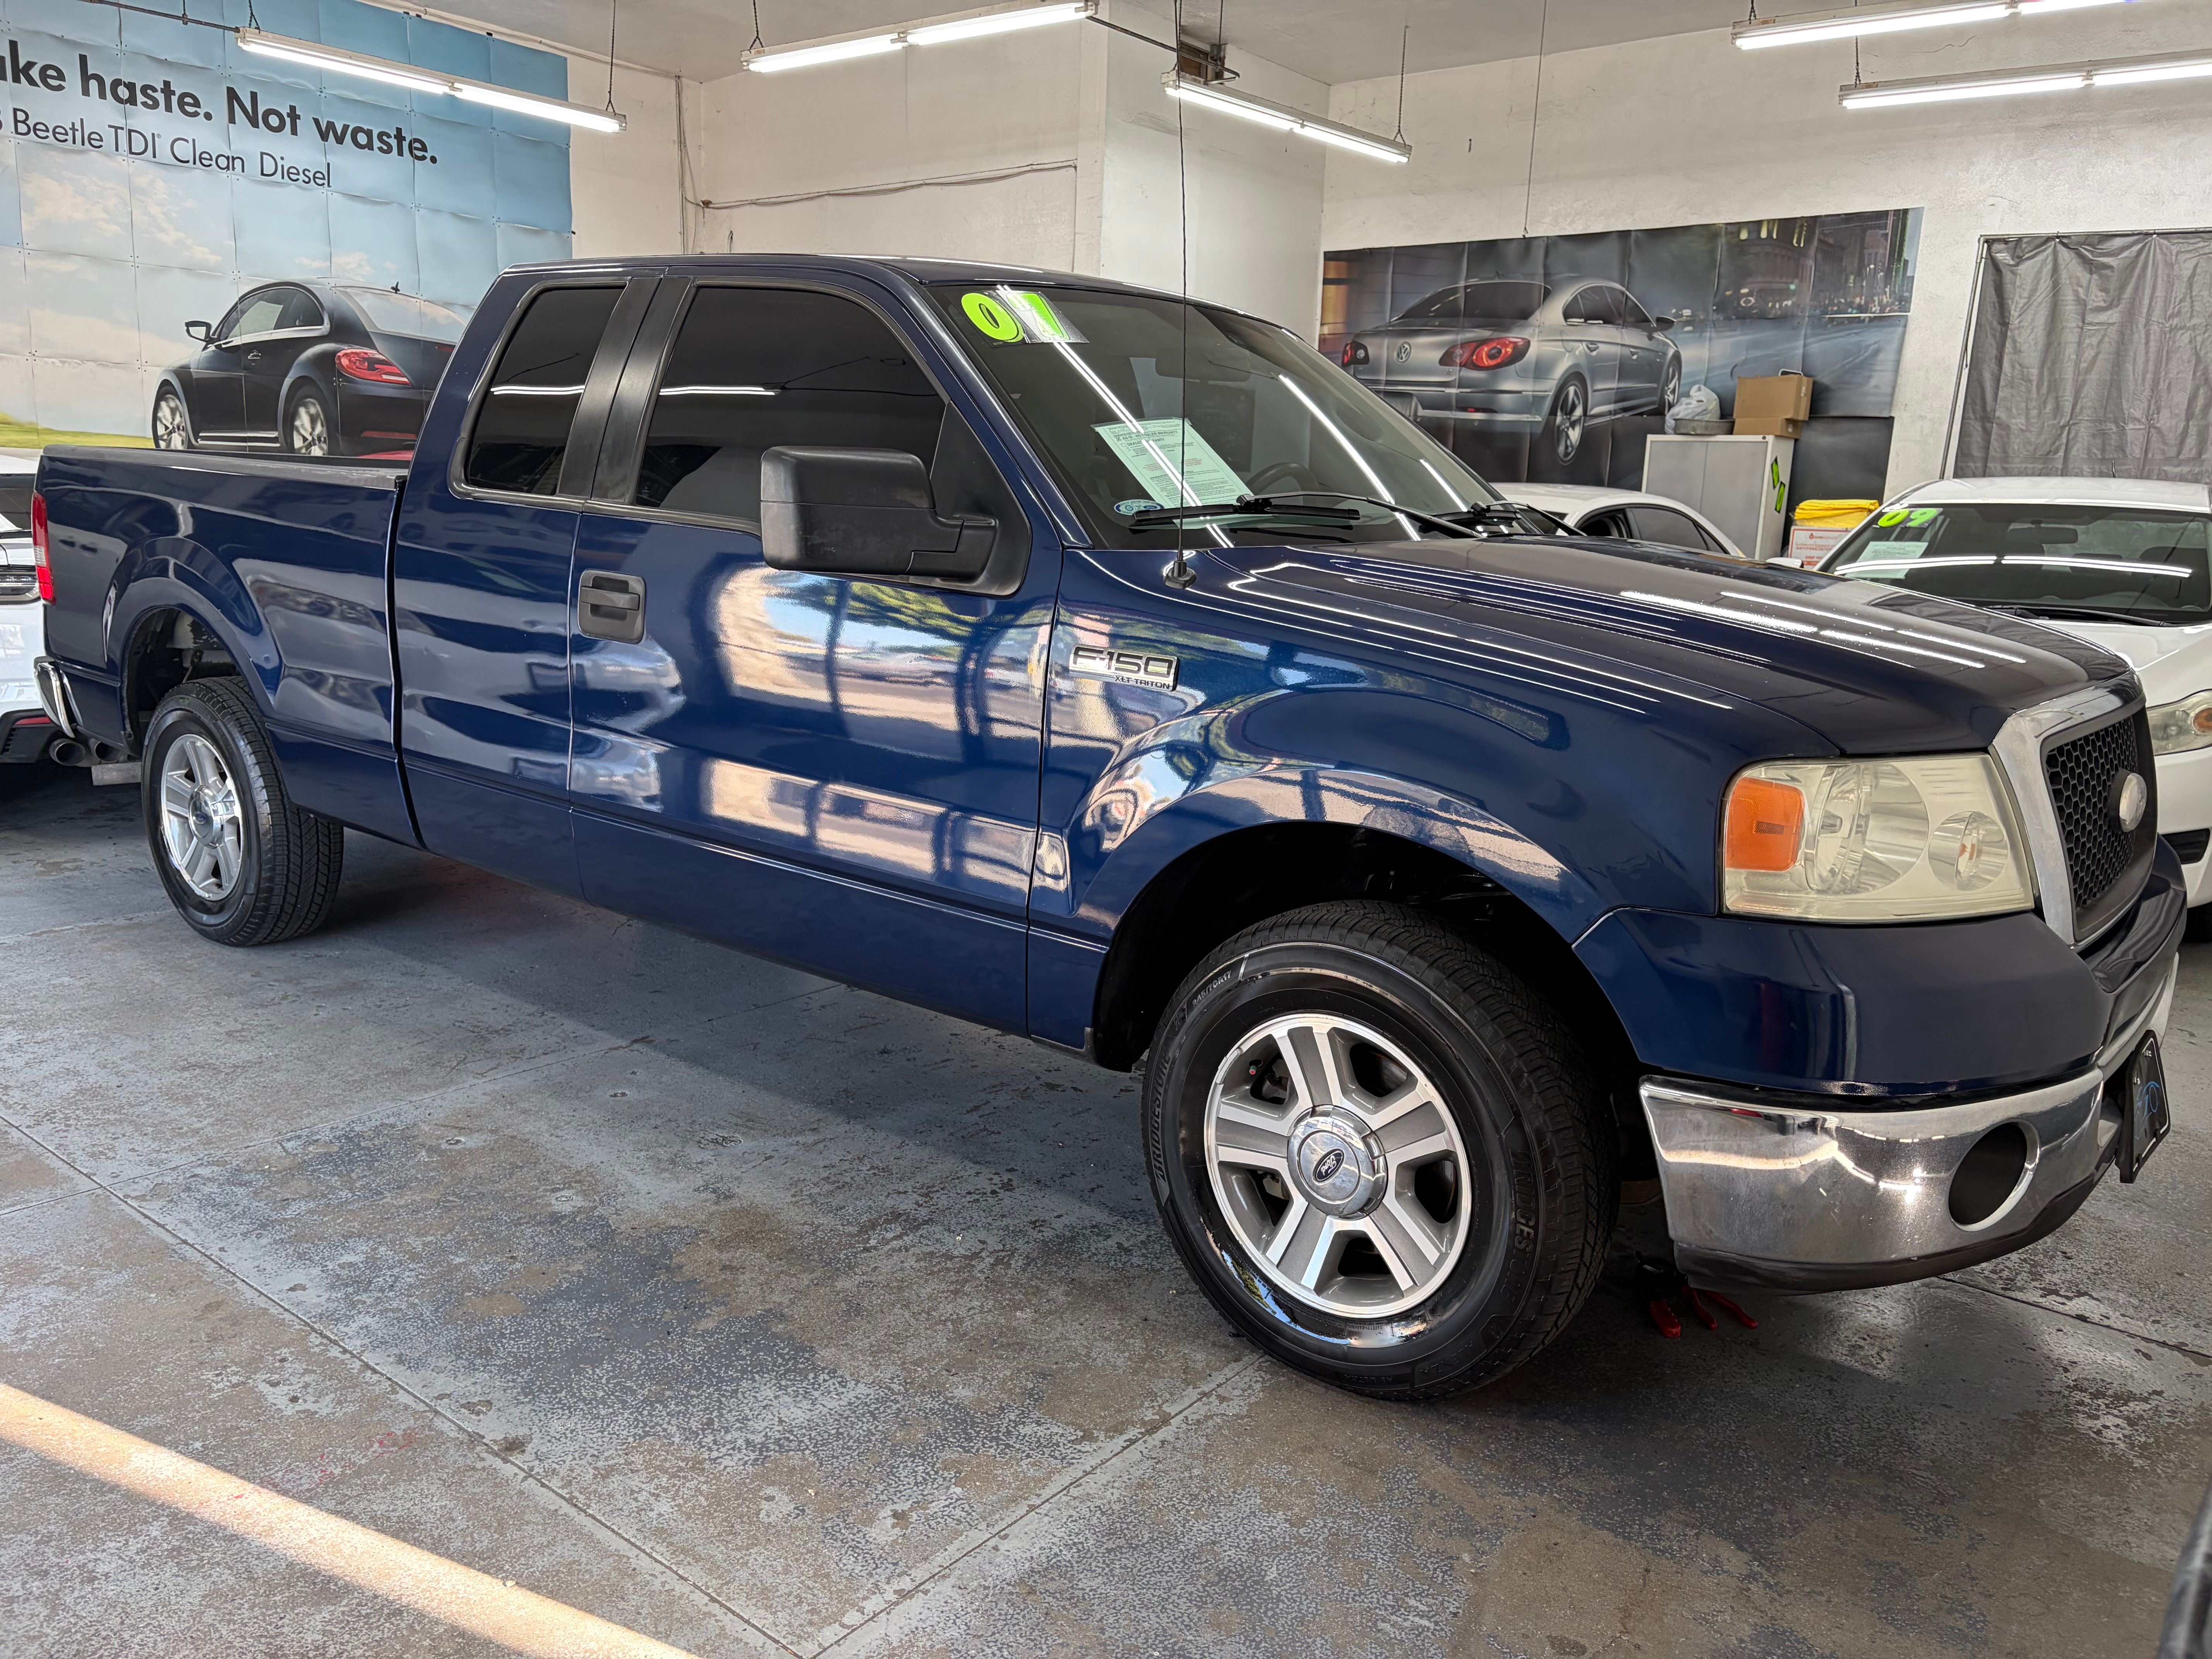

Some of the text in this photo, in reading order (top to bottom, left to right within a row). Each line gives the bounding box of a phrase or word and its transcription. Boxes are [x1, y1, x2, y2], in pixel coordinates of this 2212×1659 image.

[0, 40, 438, 164] ke haste. Not waste.
[13, 107, 103, 149] Beetle
[170, 137, 244, 173] Clean
[260, 151, 331, 188] Diesel
[1878, 508, 1937, 527] 09
[1073, 646, 1173, 678] F-150
[1134, 678, 1170, 689] TRITON
[1192, 969, 1233, 1008] 245/70R17
[1150, 1047, 1170, 1183] BRIDGESTONE
[1321, 1155, 1337, 1176] Ford
